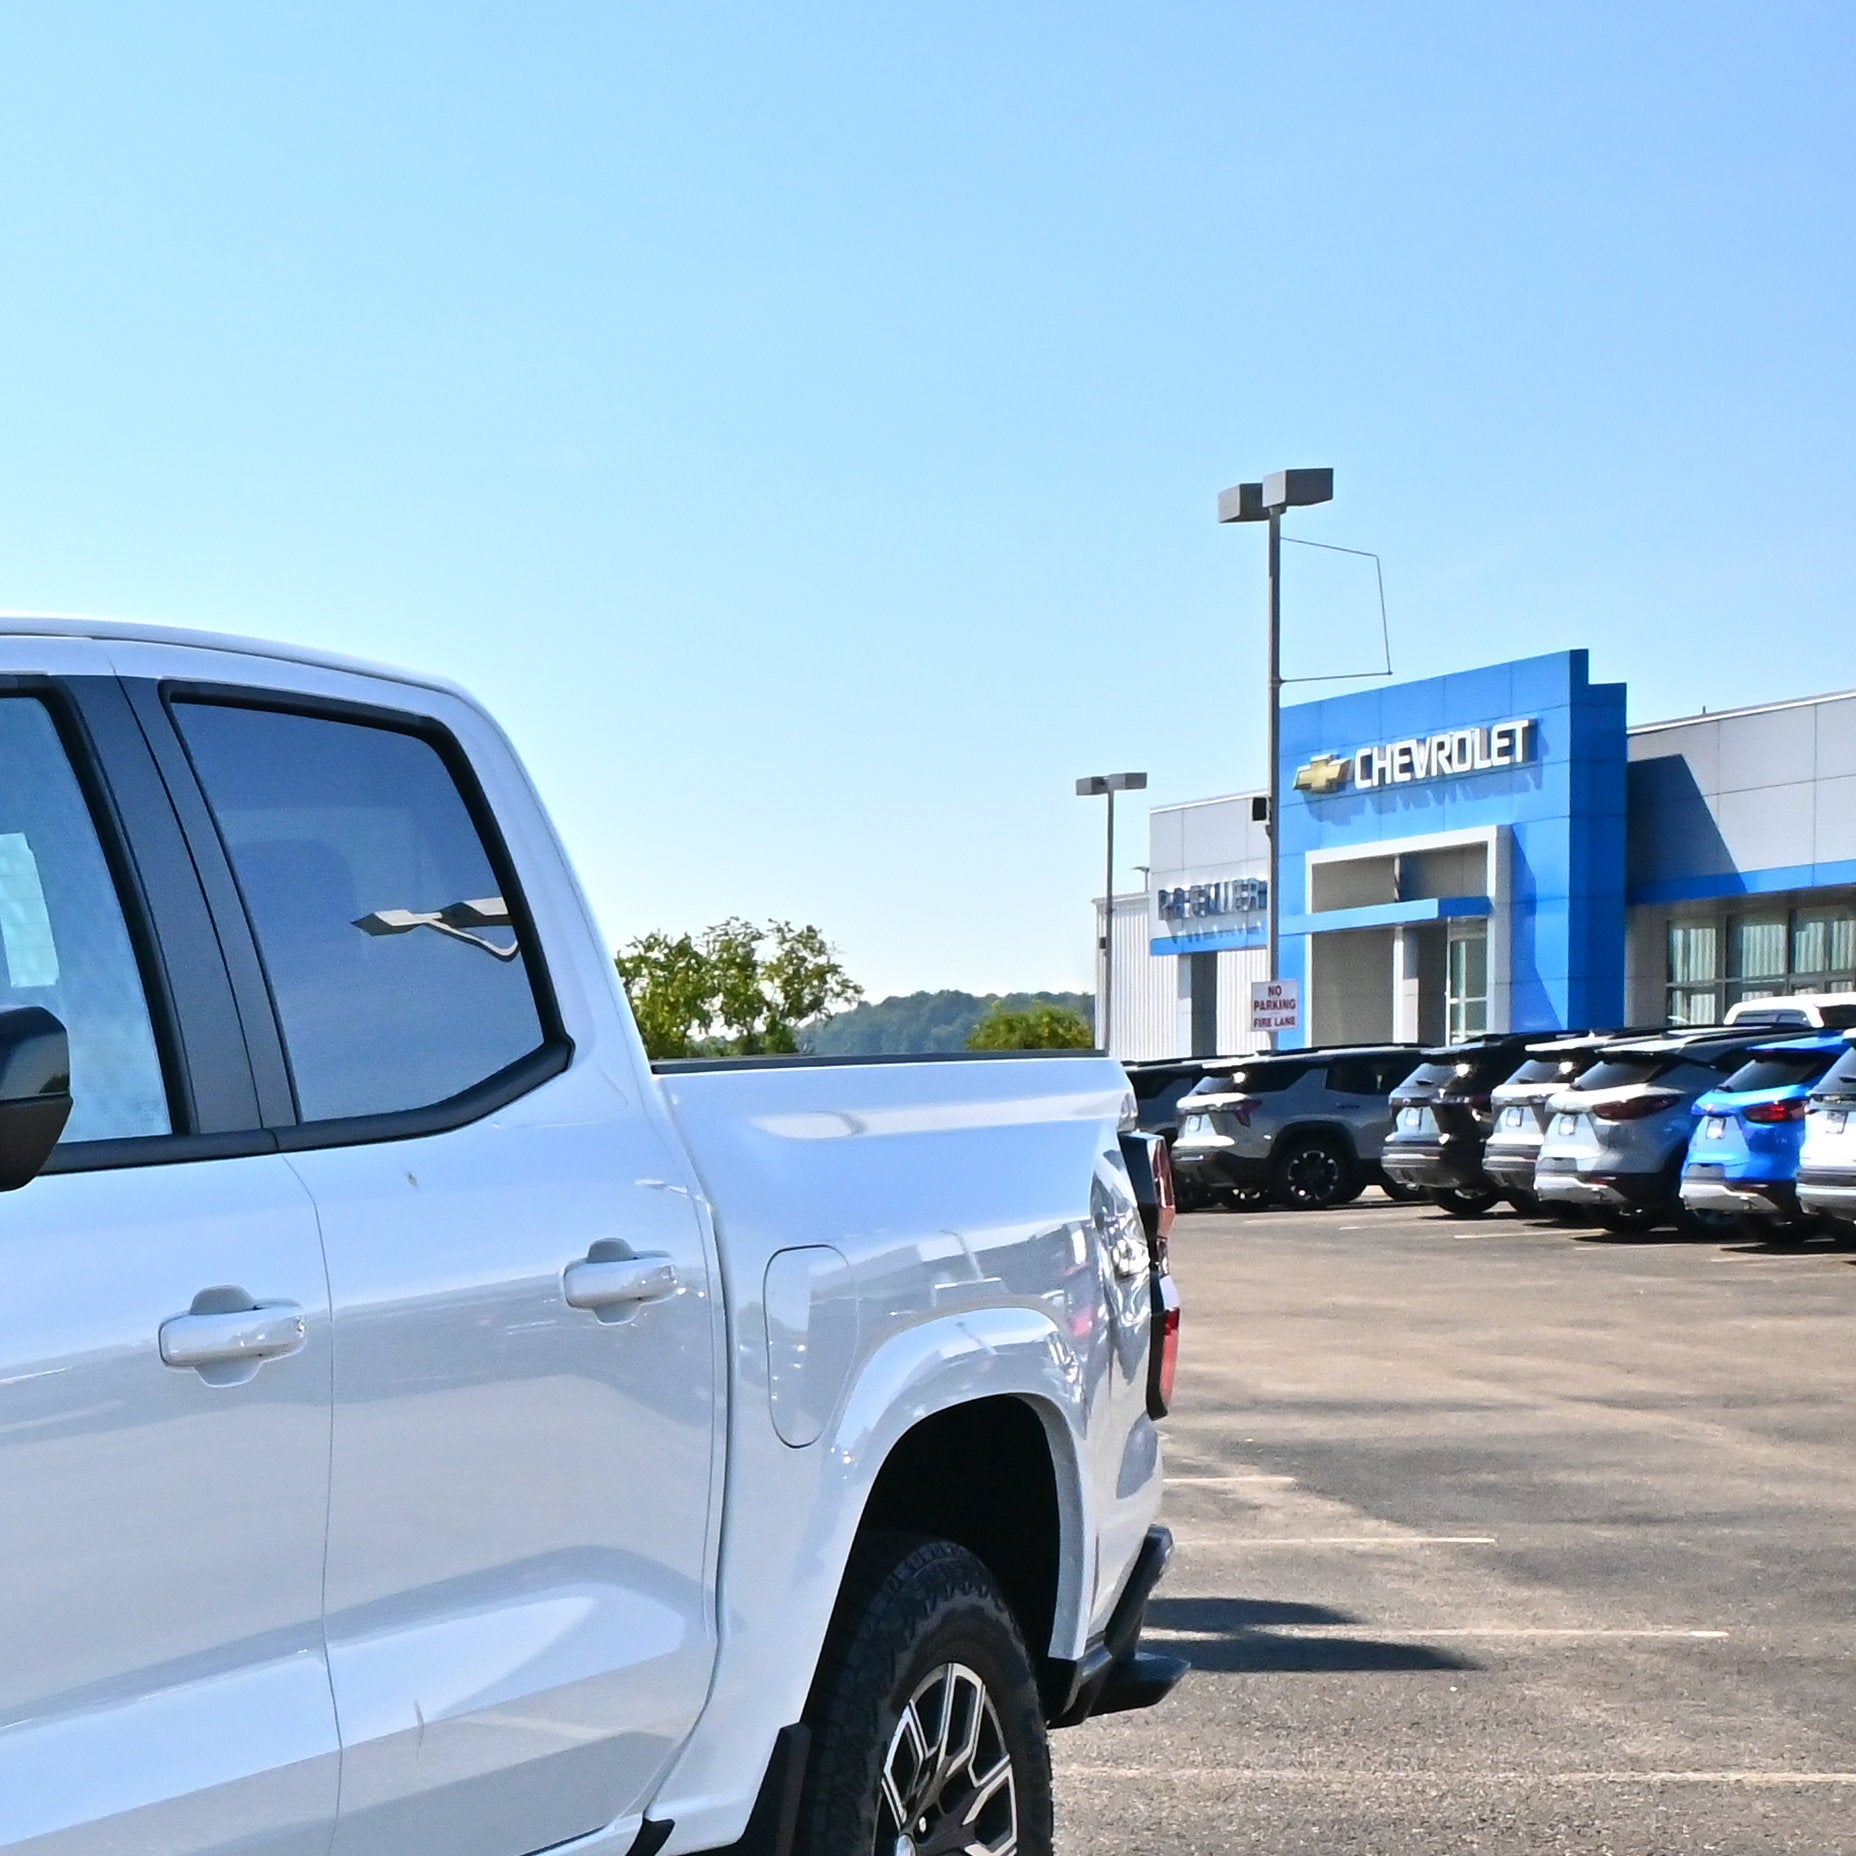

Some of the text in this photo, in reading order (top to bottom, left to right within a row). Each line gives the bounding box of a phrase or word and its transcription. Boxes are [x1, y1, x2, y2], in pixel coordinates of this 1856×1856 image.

[1354, 719, 1534, 790] CHEVROLET
[1267, 985, 1282, 997] NO
[1253, 998, 1296, 1012] PARKING
[1253, 1016, 1296, 1028] FIRE LANE
